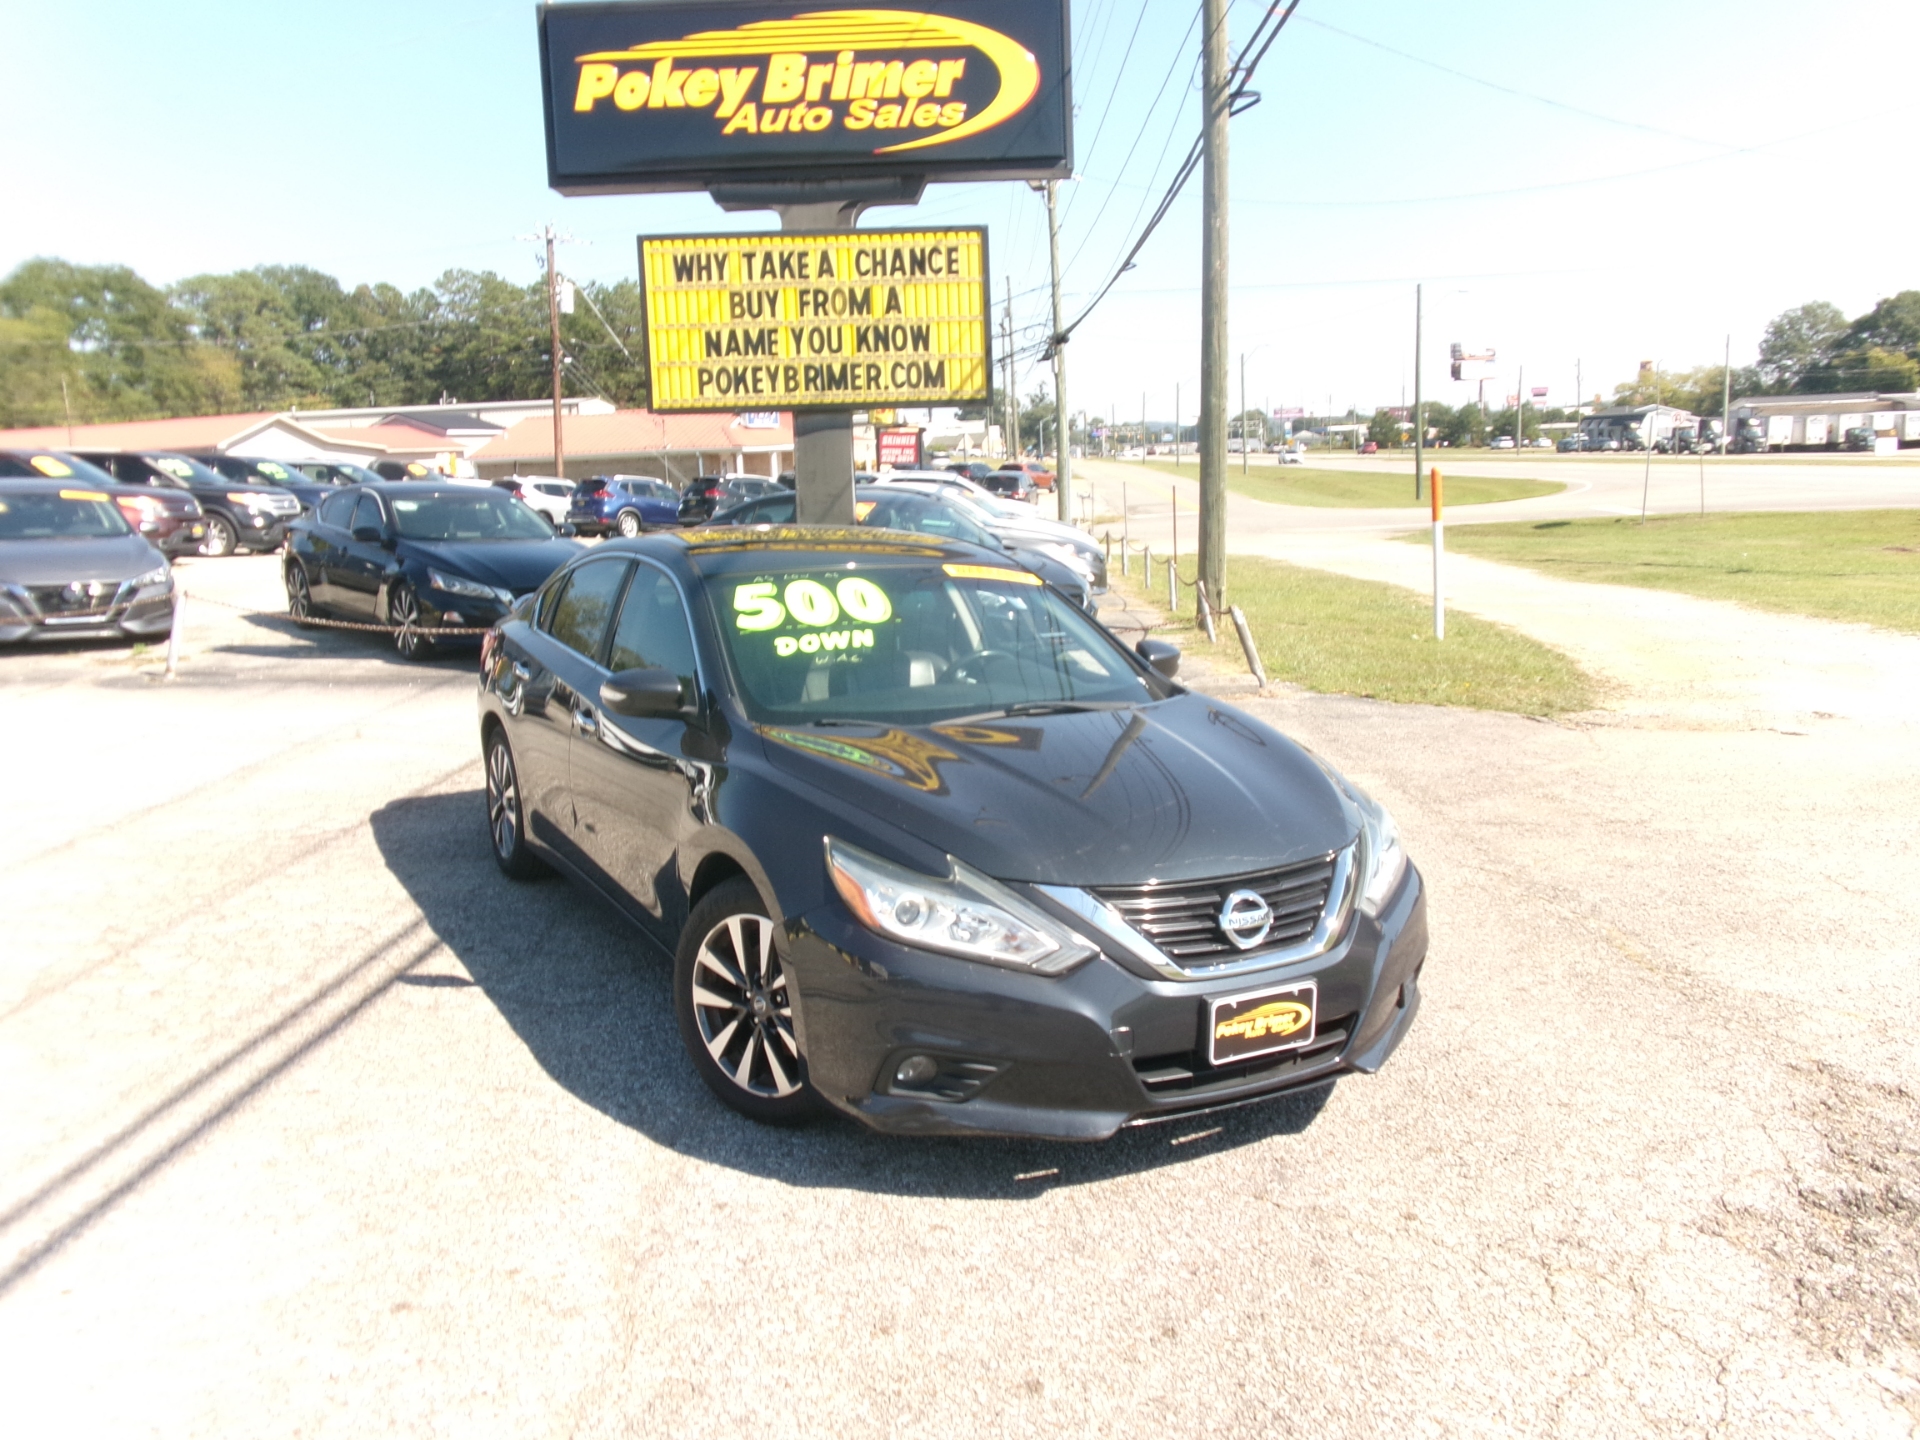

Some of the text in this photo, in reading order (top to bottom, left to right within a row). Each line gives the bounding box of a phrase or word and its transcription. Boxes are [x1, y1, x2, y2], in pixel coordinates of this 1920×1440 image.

[574, 50, 966, 118] Pokey Brimer
[722, 97, 968, 135] Auto Sales
[673, 245, 960, 283] WHY TAKE A CHANCE
[729, 285, 903, 320] BUY FROM A
[704, 324, 931, 358] NAME YOU KNOW
[698, 360, 946, 396] POKEYBRIMER.COM
[733, 576, 893, 633] 500
[773, 628, 875, 657] DOWN
[1228, 913, 1268, 927] NISSAN
[1215, 1020, 1254, 1039] Pokey
